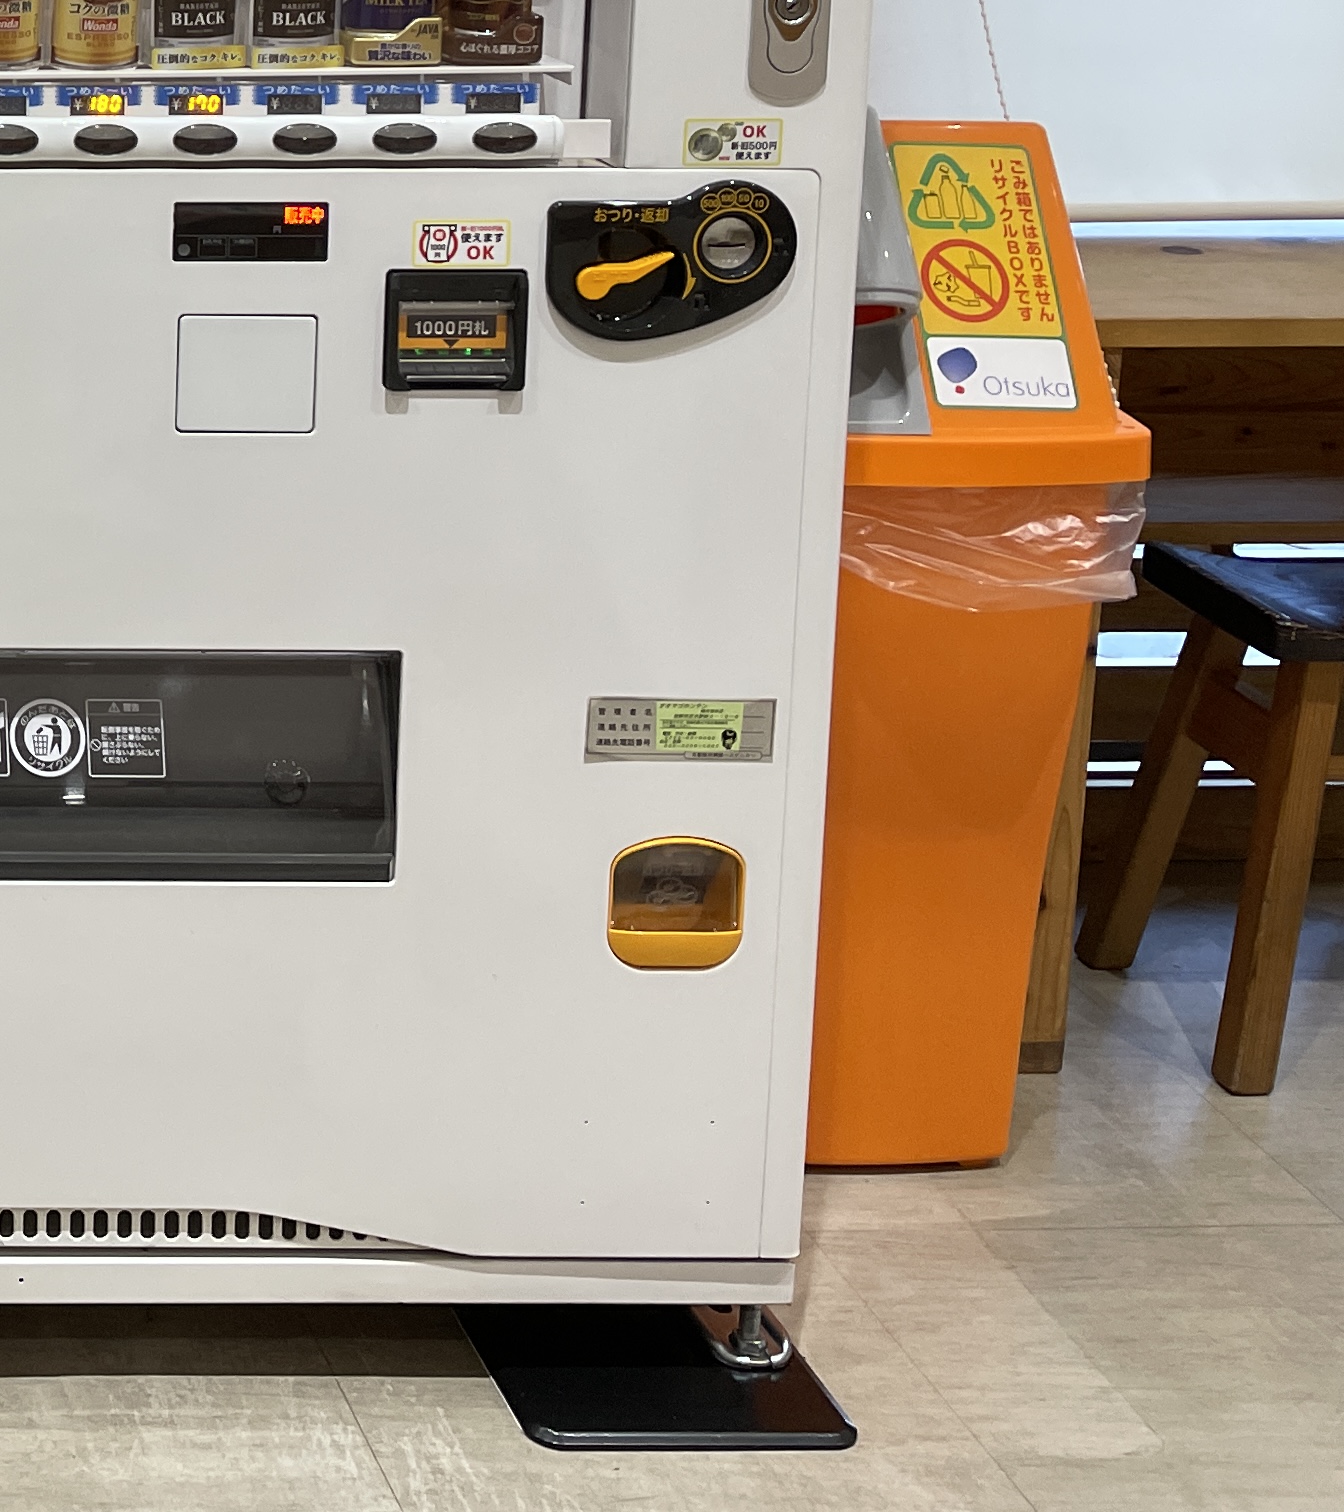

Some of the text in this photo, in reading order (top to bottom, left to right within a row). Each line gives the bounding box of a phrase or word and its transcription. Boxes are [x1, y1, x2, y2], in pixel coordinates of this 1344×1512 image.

[171, 11, 225, 26] BLACK
[272, 11, 325, 26] BLACK
[743, 125, 766, 137] OK
[285, 206, 324, 225] 販売中
[991, 159, 1033, 321] リサイクルBOXです
[467, 246, 494, 260] OK
[415, 321, 489, 335] 1000円札
[983, 376, 1070, 398] Otsuka
